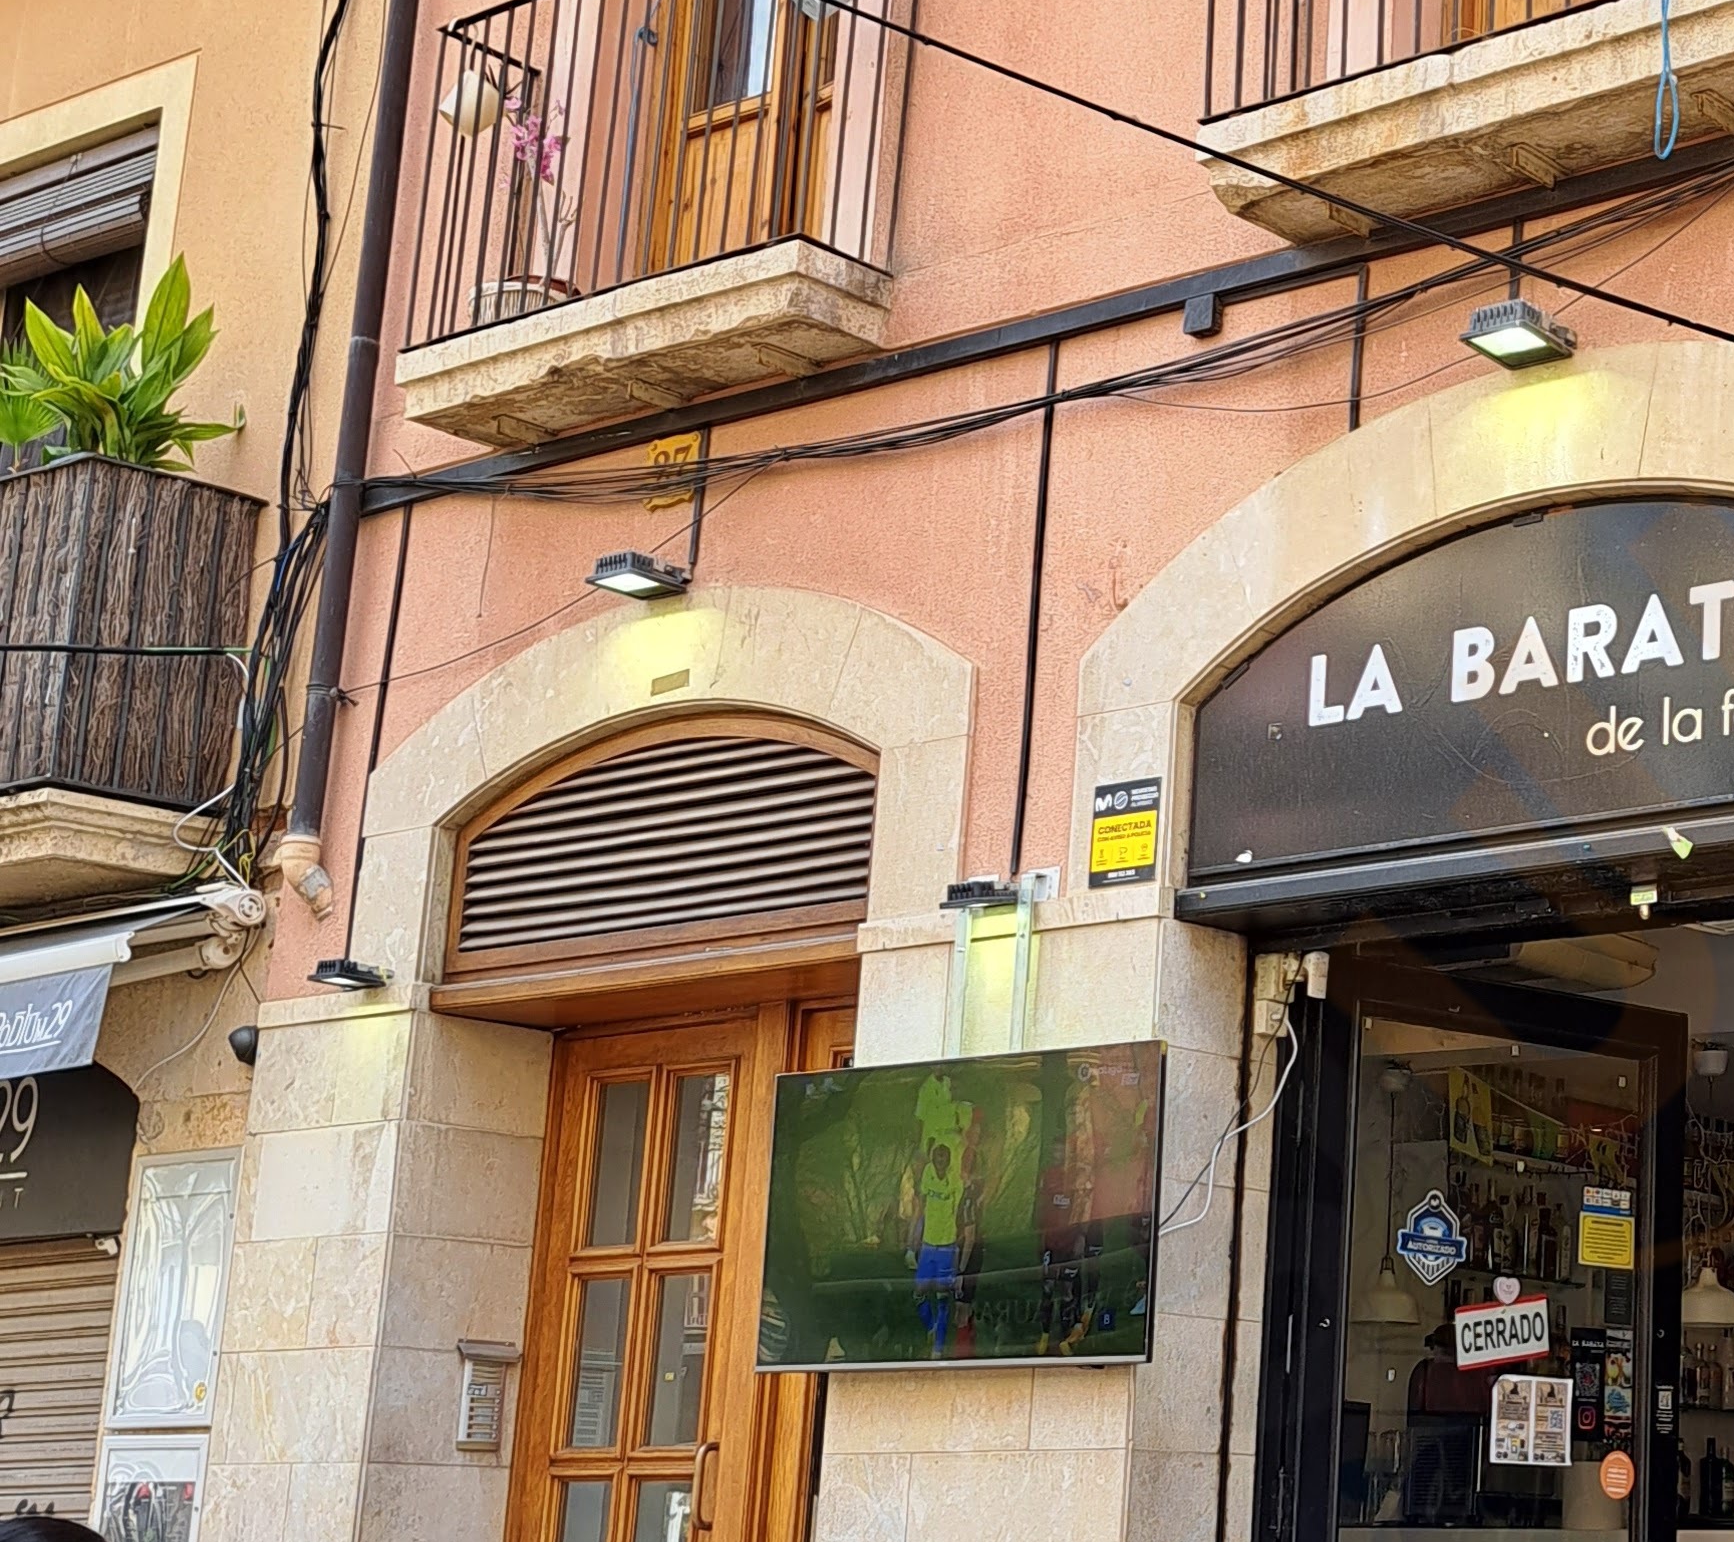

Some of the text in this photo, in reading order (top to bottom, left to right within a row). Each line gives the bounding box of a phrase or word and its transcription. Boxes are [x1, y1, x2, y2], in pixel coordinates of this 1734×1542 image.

[1307, 644, 1402, 728] LA
[1586, 706, 1644, 757] de
[1662, 696, 1703, 744] la
[1461, 1311, 1545, 1354] CERRADO
